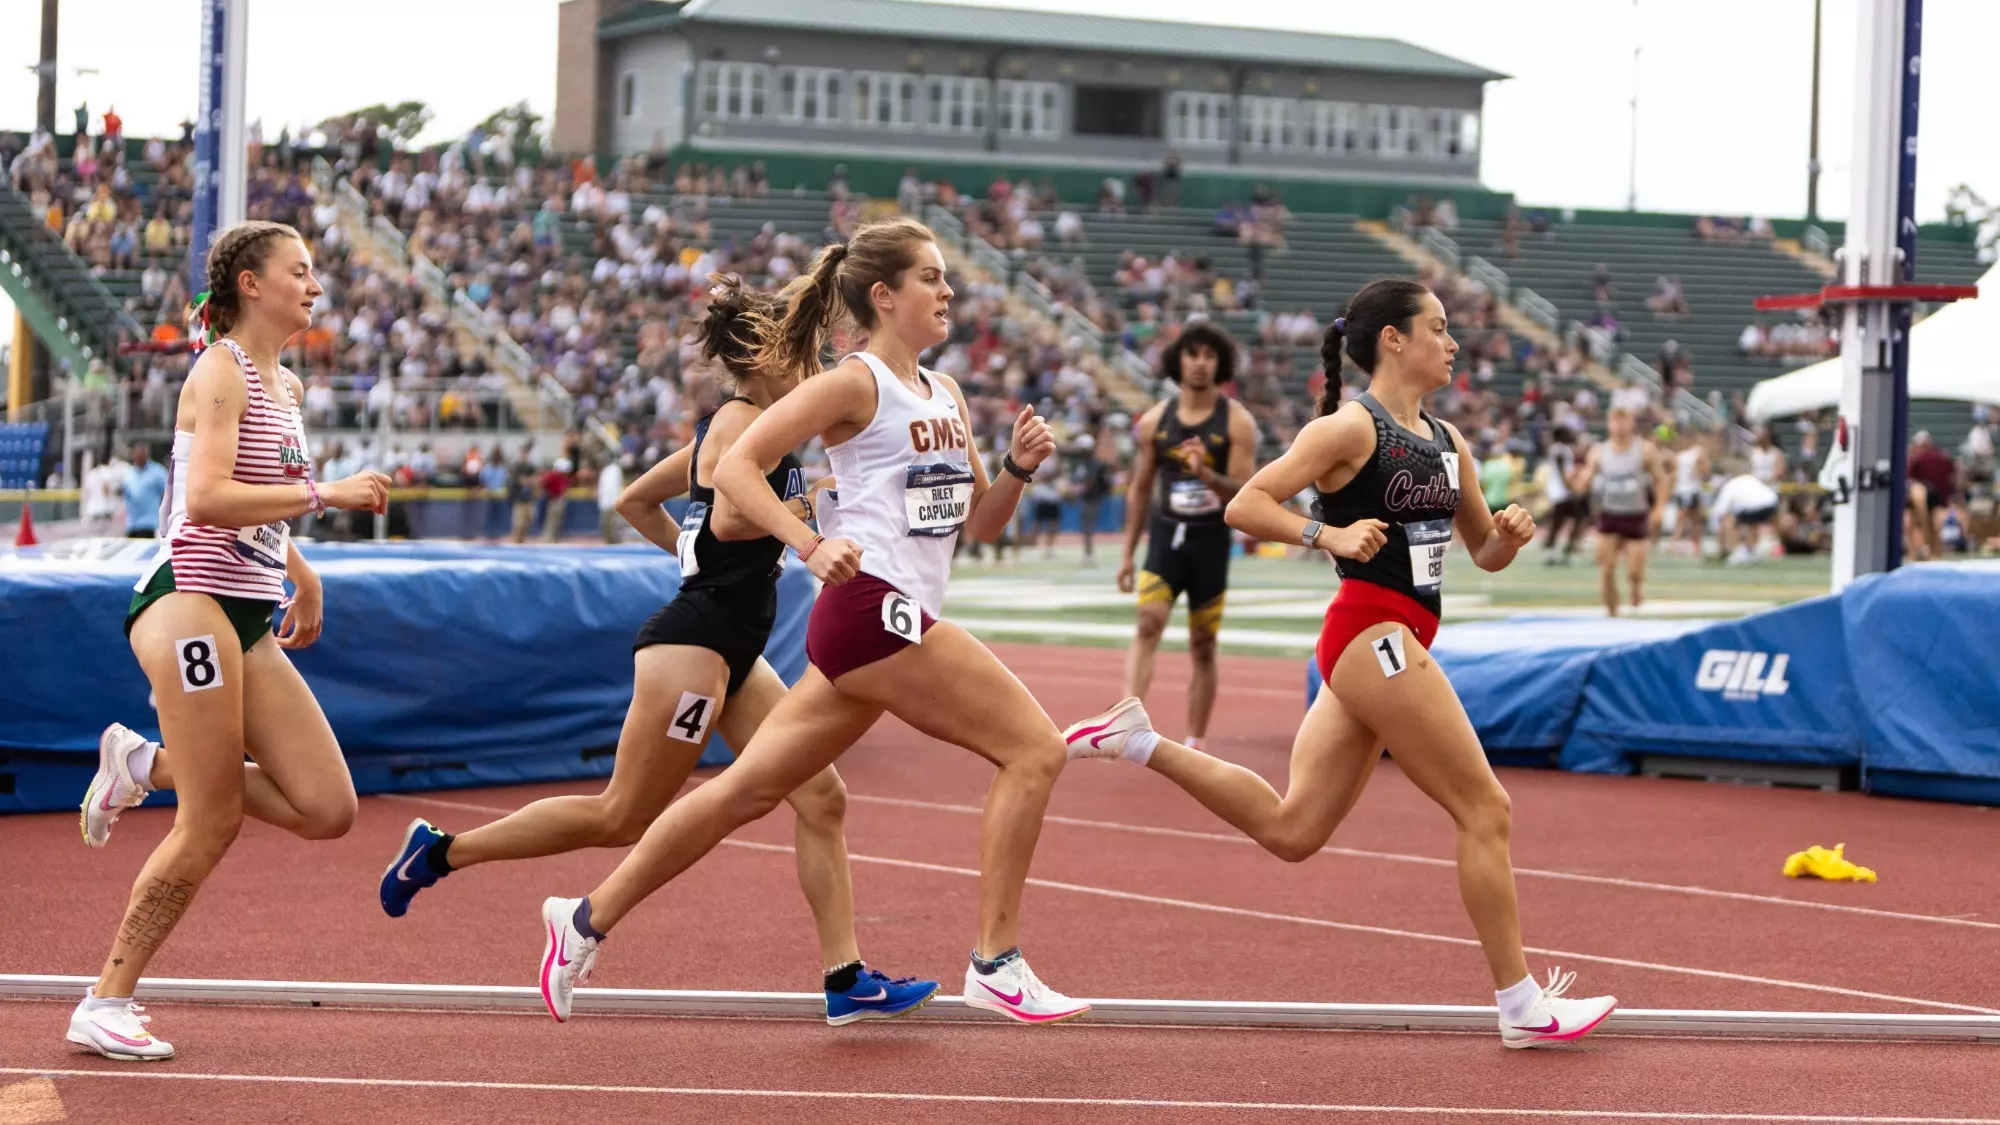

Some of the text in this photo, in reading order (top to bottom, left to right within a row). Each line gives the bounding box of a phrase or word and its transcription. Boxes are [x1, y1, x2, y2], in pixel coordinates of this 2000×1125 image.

[909, 417, 967, 453] CMS
[279, 445, 309, 466] WAS
[782, 468, 807, 502] A
[931, 487, 954, 501] RILEY
[890, 598, 912, 635] 6
[183, 641, 216, 687] 8
[1378, 638, 1402, 671] 1
[1695, 649, 1790, 695] GILL
[675, 699, 708, 739] 4
[166, 878, 194, 907] NOT
[117, 876, 171, 946] FOR THEM
[146, 906, 179, 933] FOR
